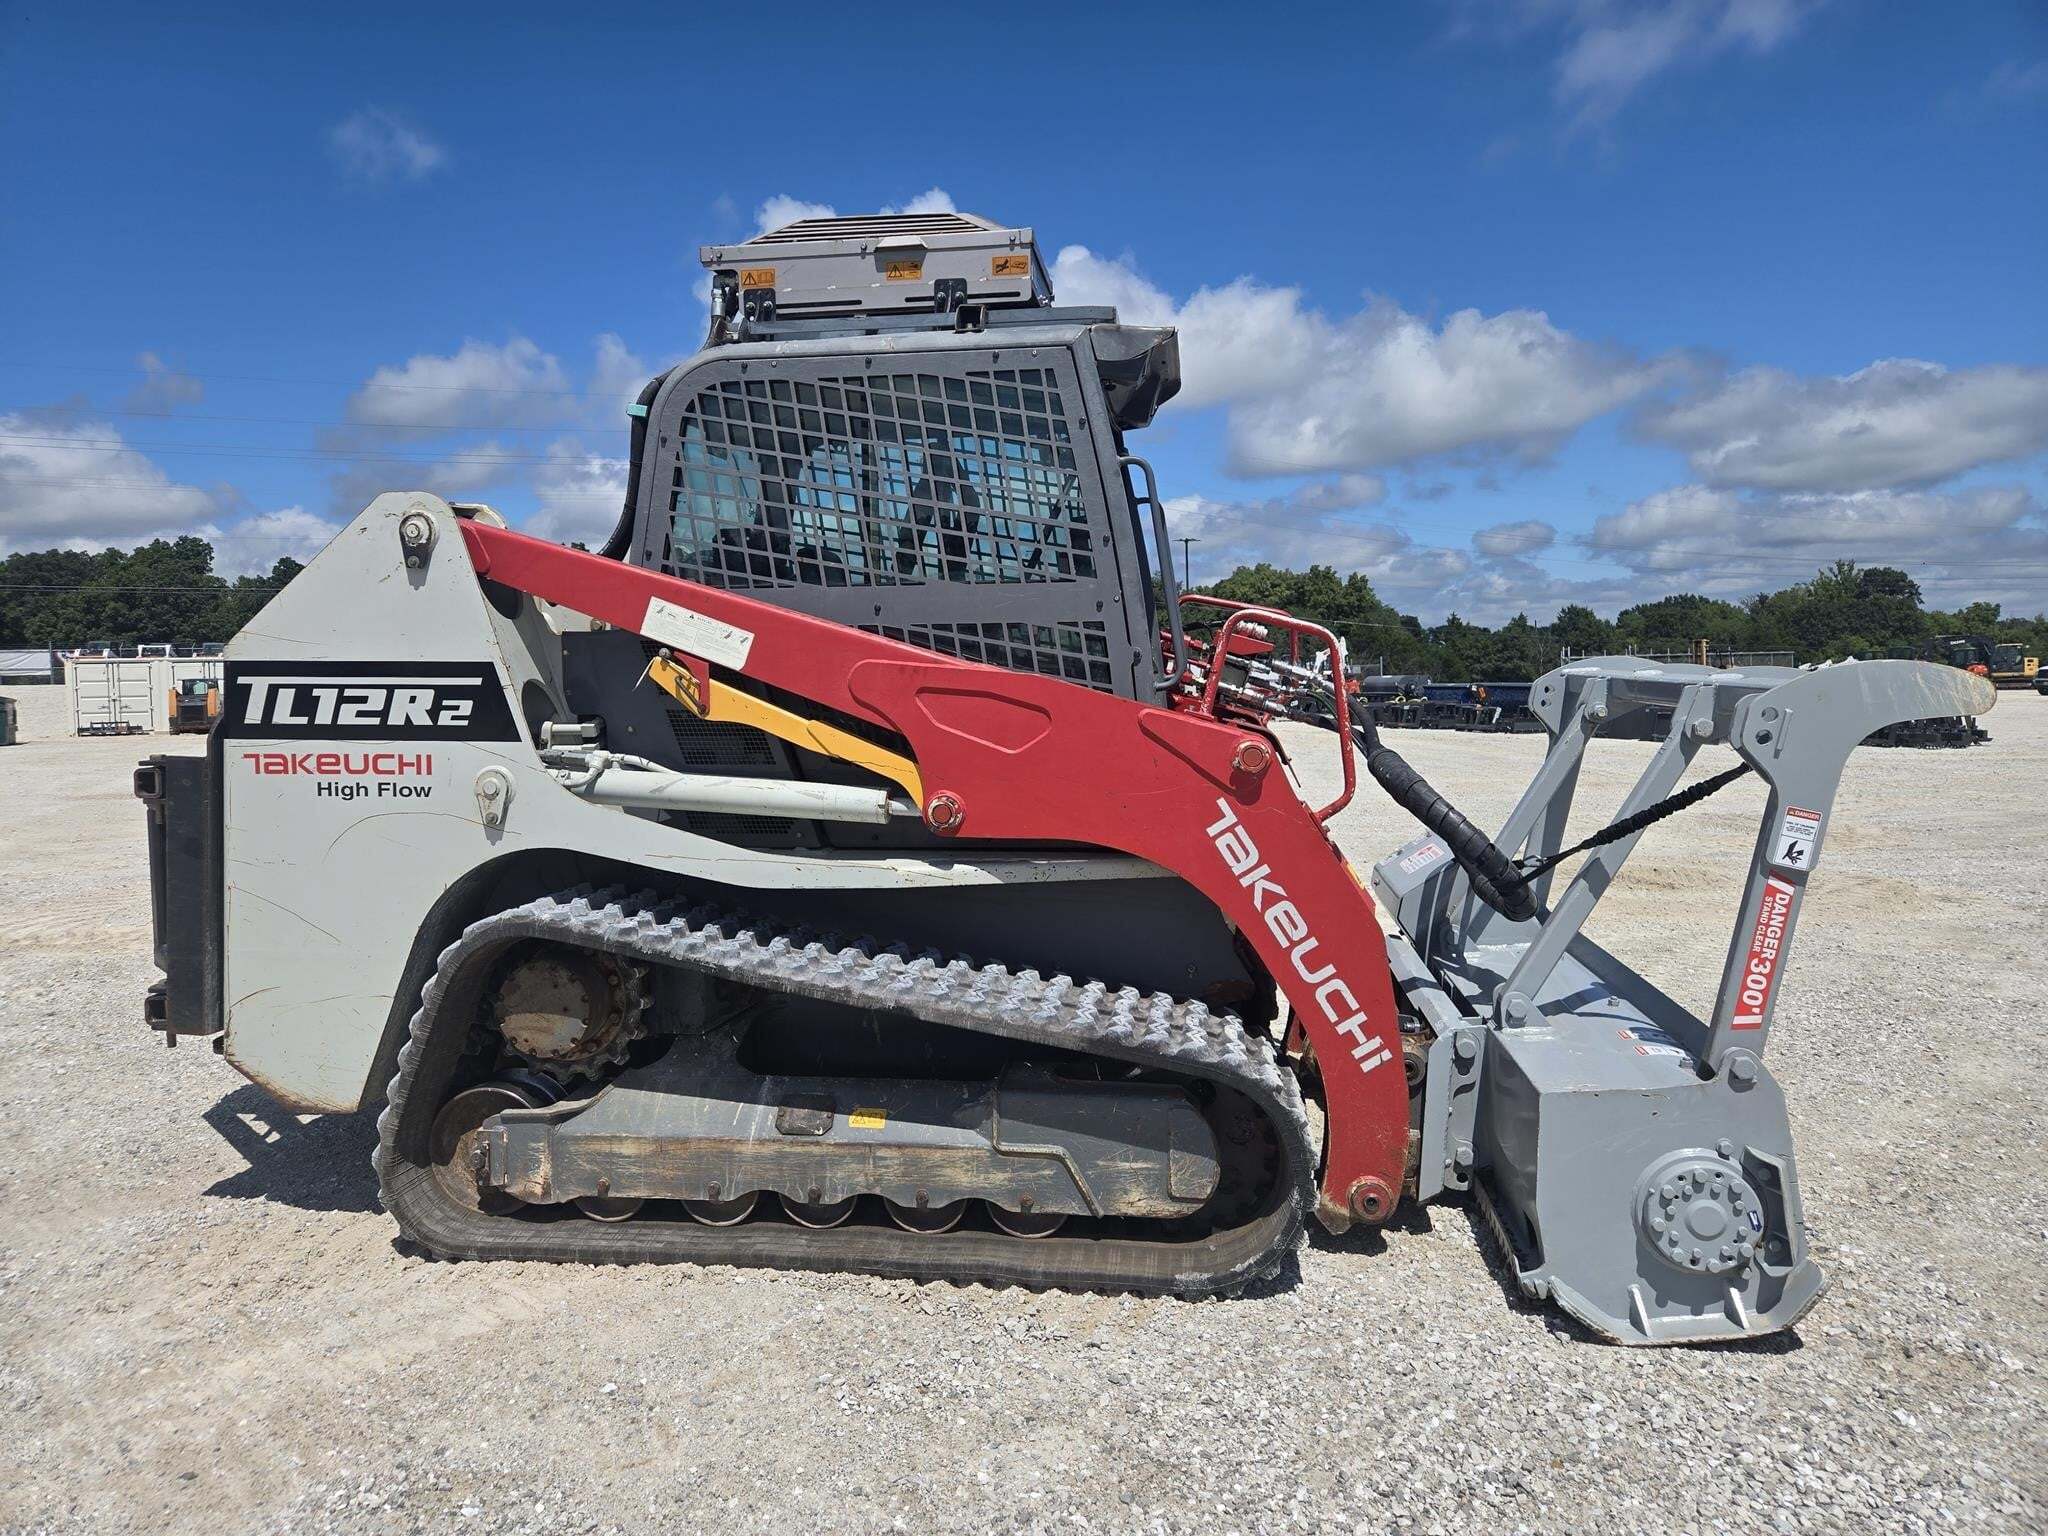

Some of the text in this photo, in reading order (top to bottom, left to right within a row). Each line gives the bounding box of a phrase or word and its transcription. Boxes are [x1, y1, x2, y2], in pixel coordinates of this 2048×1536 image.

[237, 676, 483, 726] TL12R2
[241, 753, 433, 776] TAKEUCHI
[316, 782, 432, 800] High Flow
[1795, 810, 1820, 820] DANGER
[1206, 797, 1393, 1074] TAKEUCHI
[1752, 895, 1773, 952] STAND CLEAR
[1761, 892, 1790, 960] DANGER
